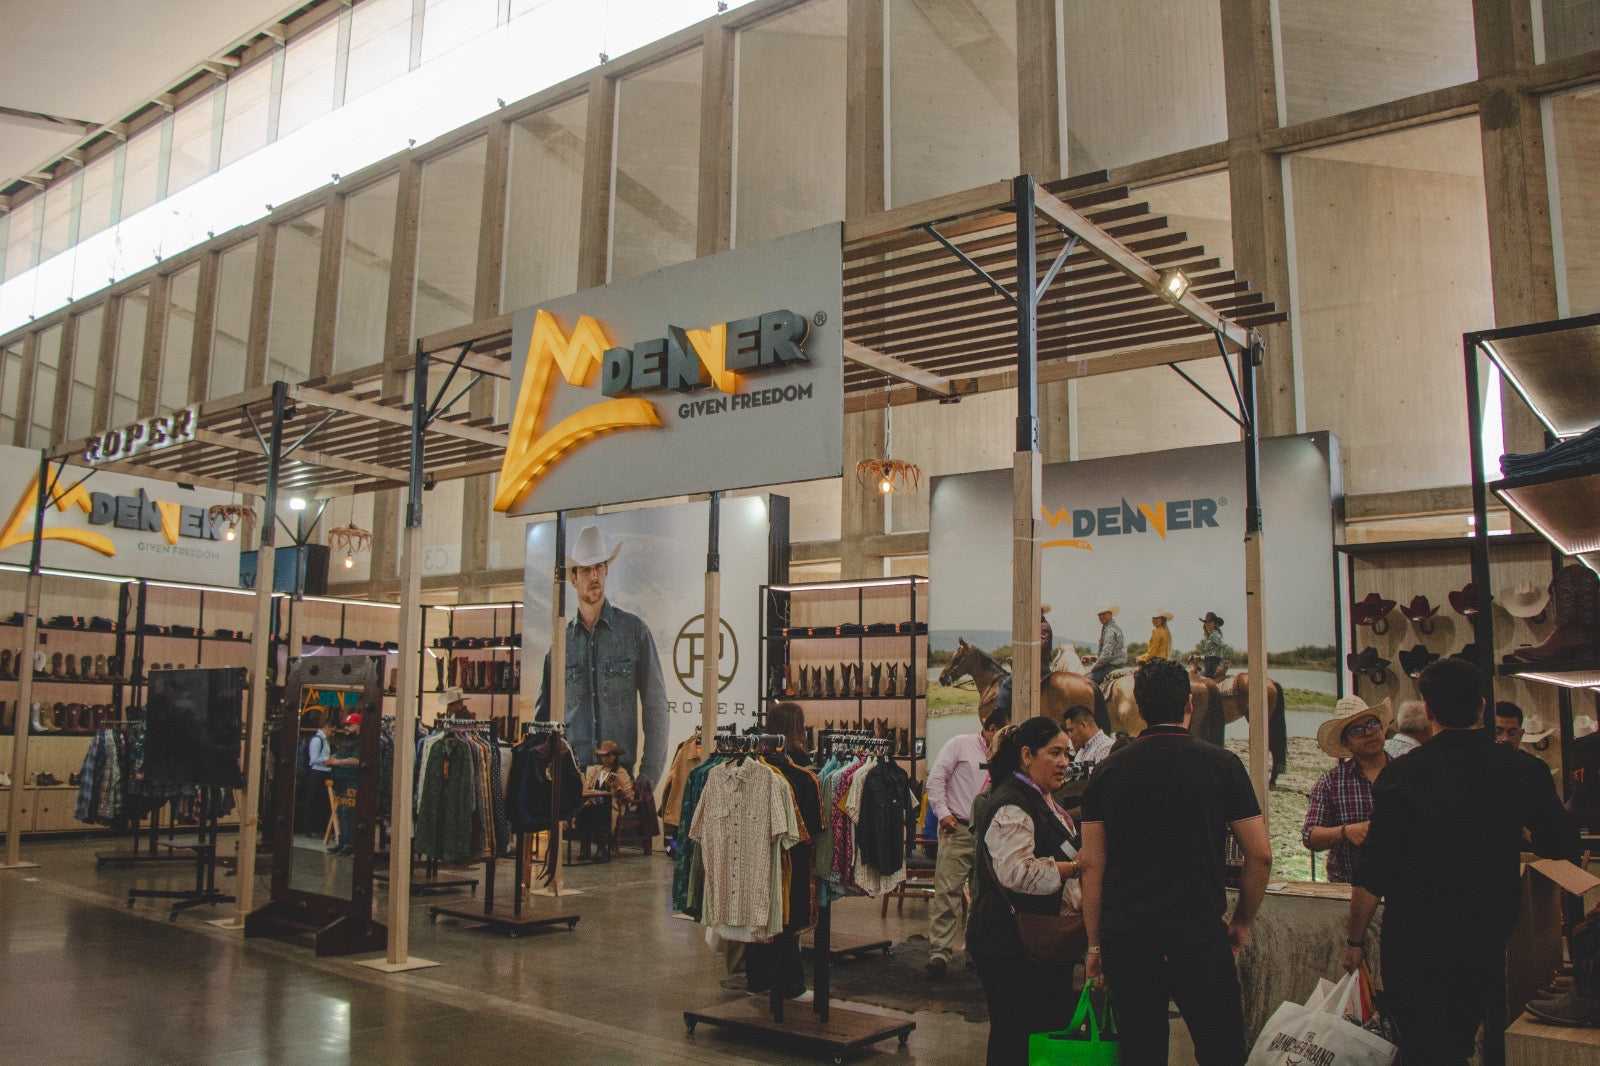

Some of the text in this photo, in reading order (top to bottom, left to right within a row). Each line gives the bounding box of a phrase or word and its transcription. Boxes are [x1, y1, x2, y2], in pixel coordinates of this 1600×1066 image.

[601, 309, 810, 398] DENVER
[678, 383, 812, 419] GIVEN FREEDOM
[83, 409, 192, 461] ROPER
[1072, 496, 1219, 541] DENVER
[137, 543, 220, 560] GIVEN FREEDOM
[667, 702, 745, 715] ROER
